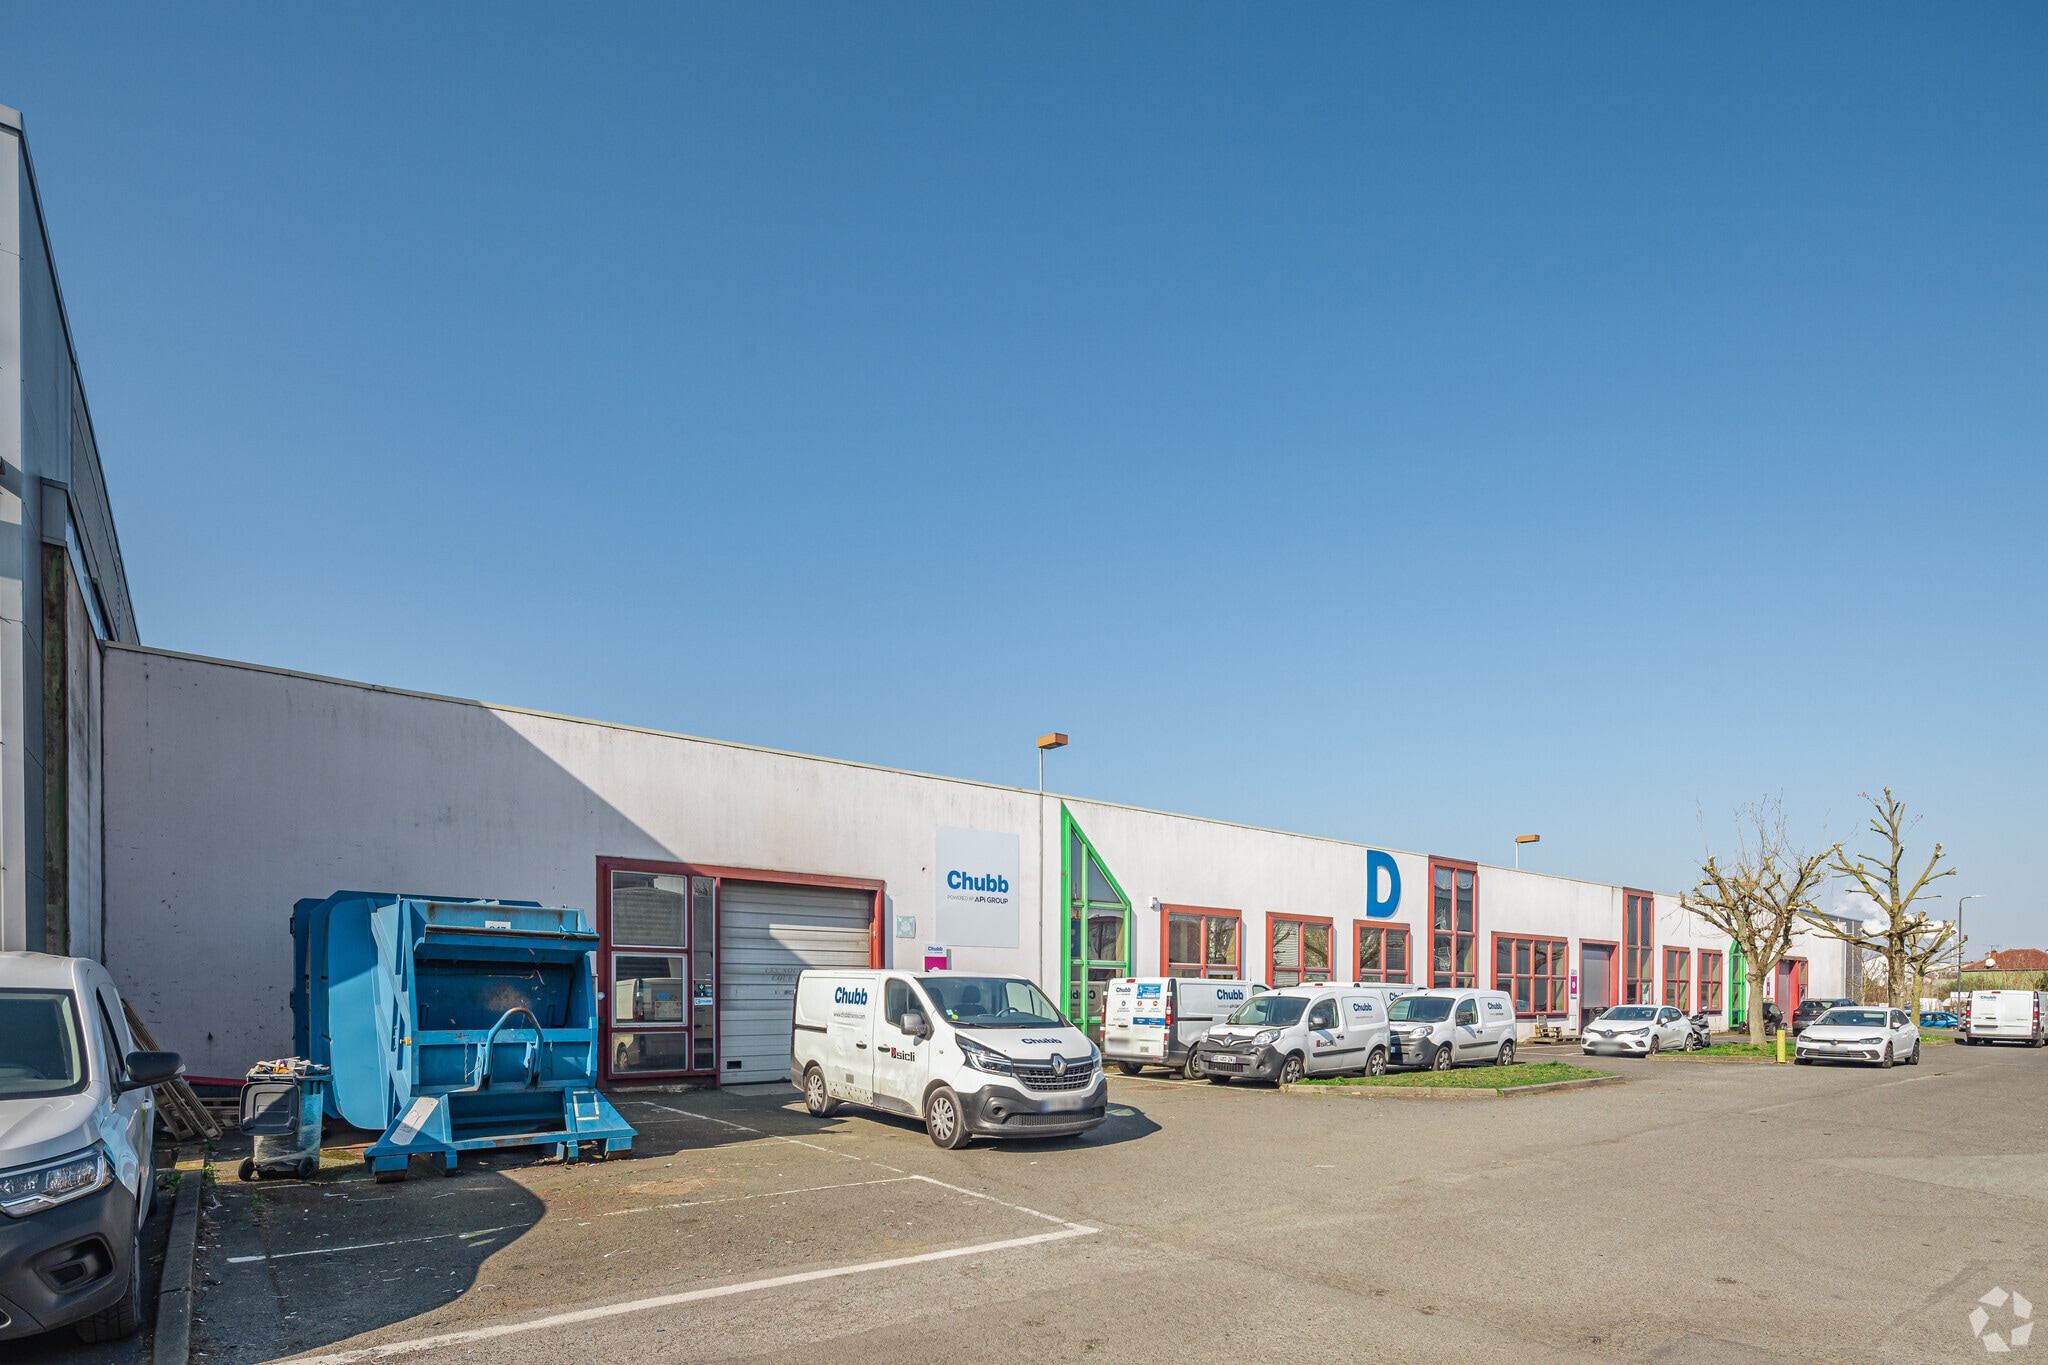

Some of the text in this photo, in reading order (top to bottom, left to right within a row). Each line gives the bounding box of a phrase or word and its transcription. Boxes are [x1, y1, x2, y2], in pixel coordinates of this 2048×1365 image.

[947, 870, 1009, 893] Chubb
[1366, 849, 1401, 918] D
[834, 986, 868, 1005] Chubb
[1216, 989, 1244, 1000] Chubb
[1352, 1003, 1373, 1012] Chubb
[1487, 1002, 1503, 1010] Chubb
[896, 1050, 915, 1062] sicli
